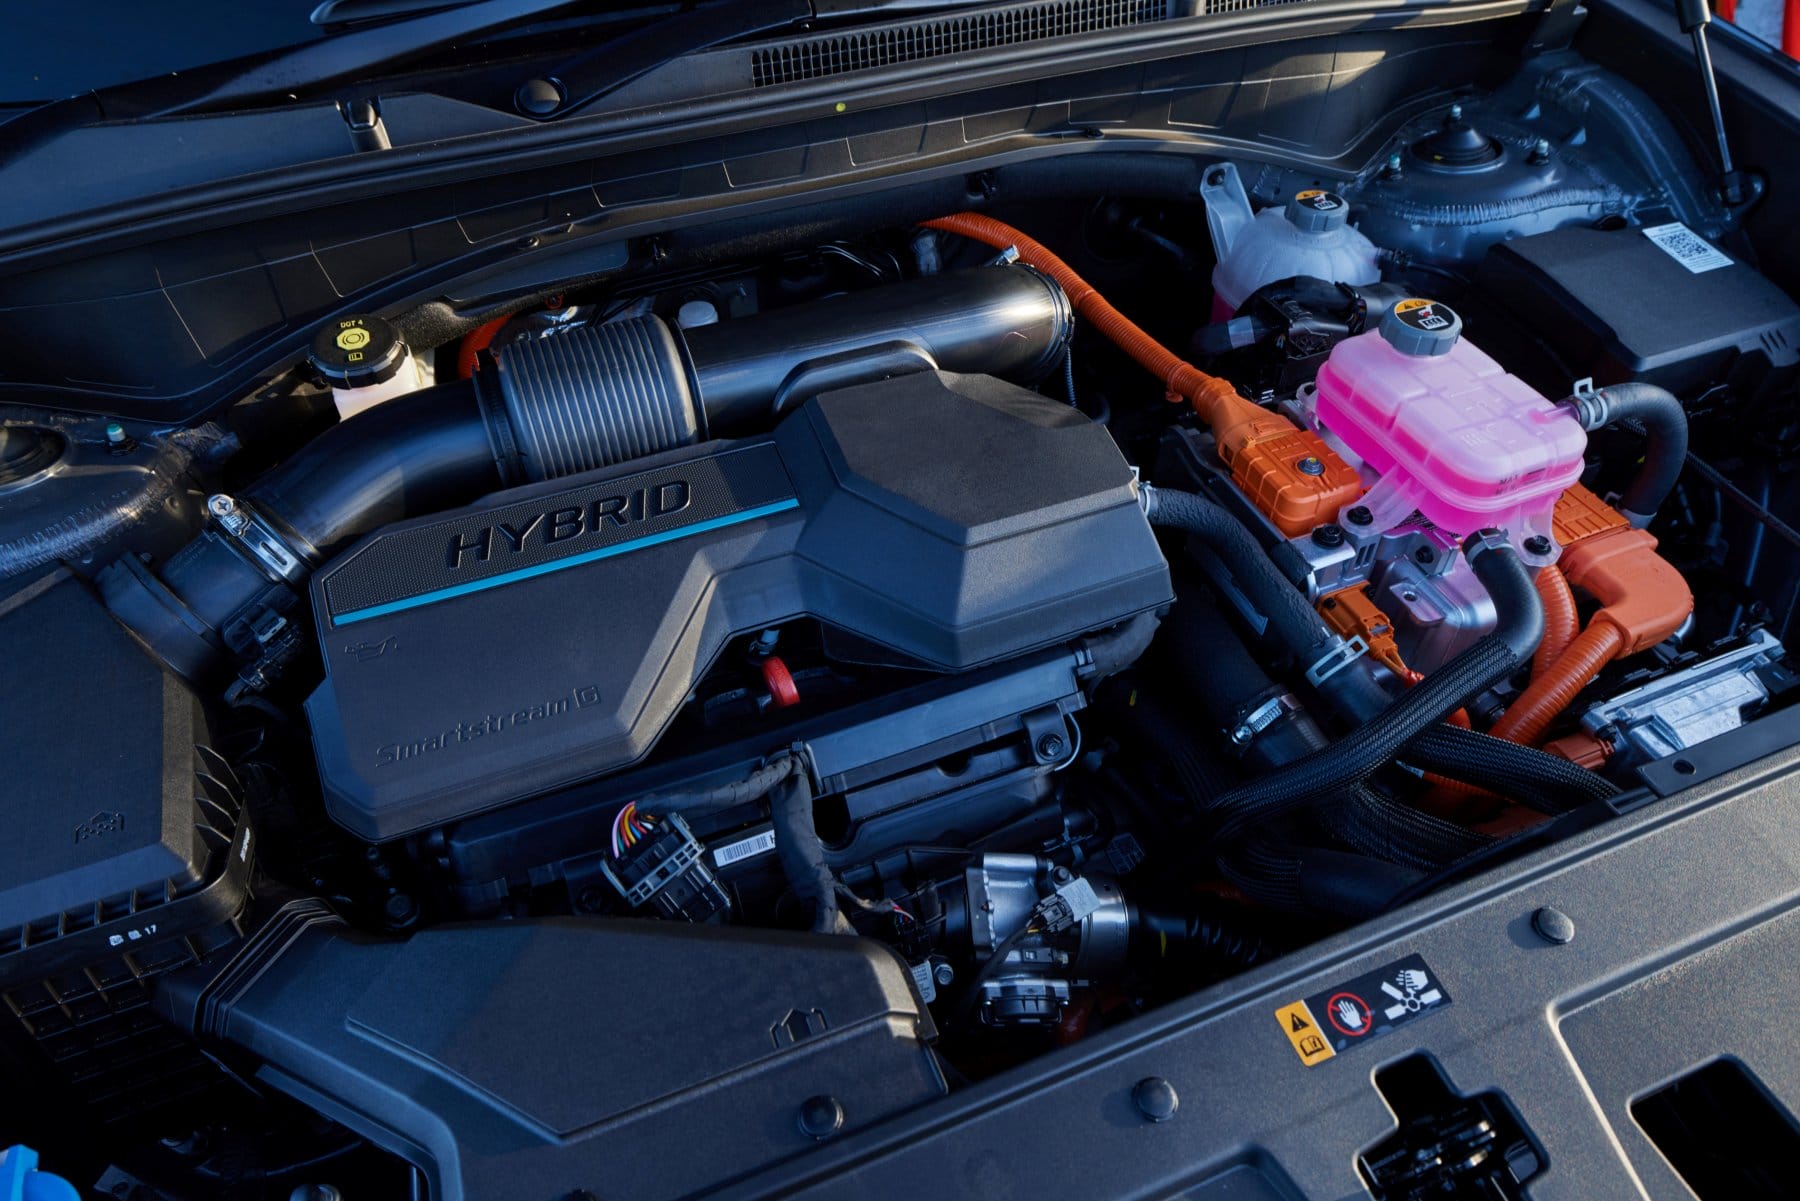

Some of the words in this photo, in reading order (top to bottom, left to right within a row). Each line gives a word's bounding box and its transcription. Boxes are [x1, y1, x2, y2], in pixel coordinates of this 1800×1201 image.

[340, 320, 356, 328] DOT
[446, 480, 692, 569] HYBRID
[375, 699, 570, 767] Smartstream
